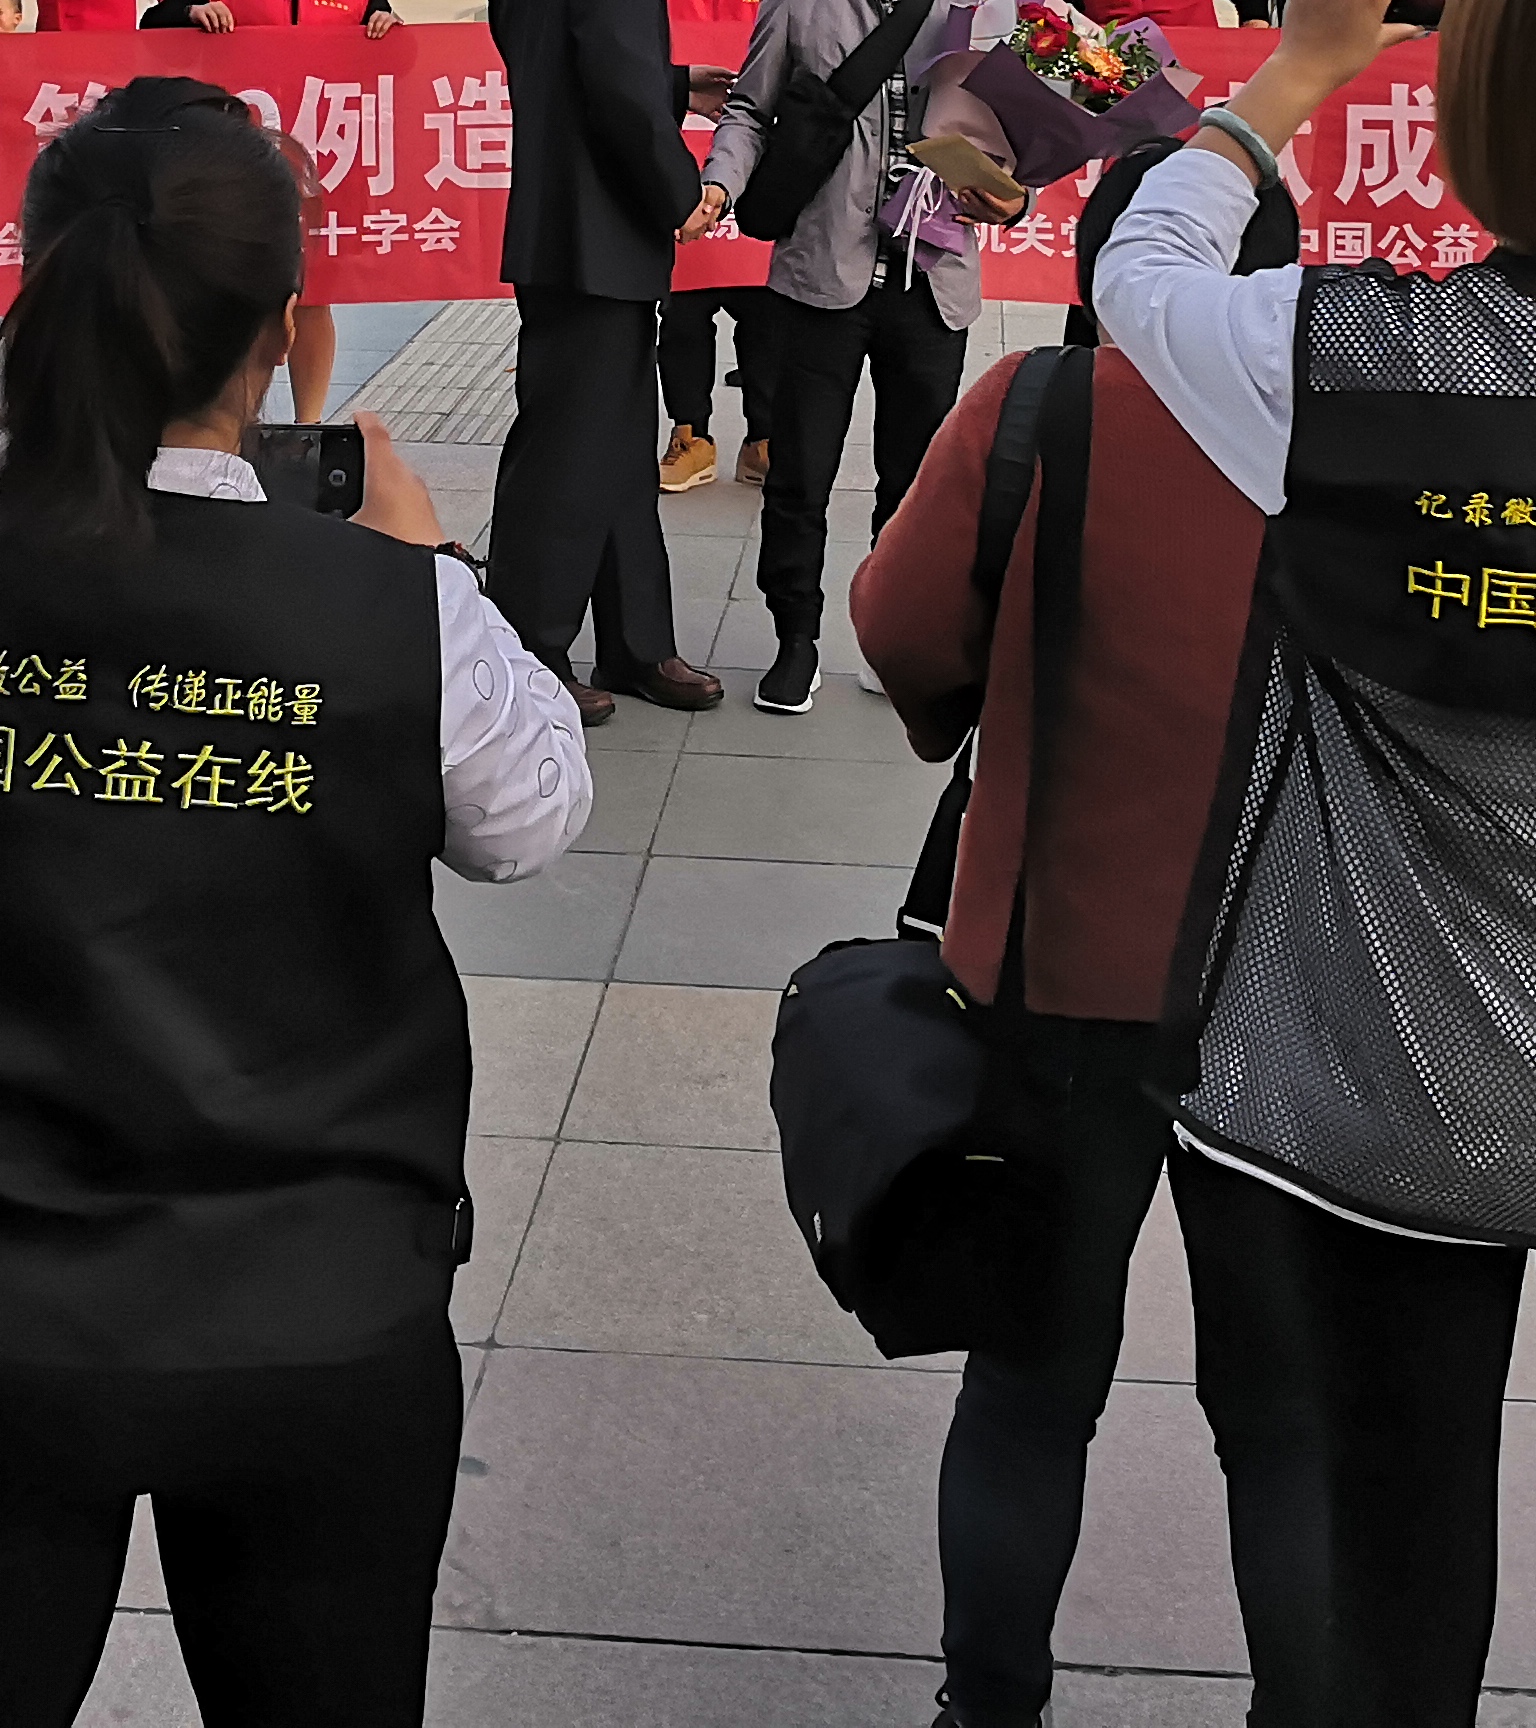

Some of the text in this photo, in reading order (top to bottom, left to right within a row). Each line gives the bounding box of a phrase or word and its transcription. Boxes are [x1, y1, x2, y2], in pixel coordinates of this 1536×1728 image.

[127, 664, 323, 725] 传递正能量
